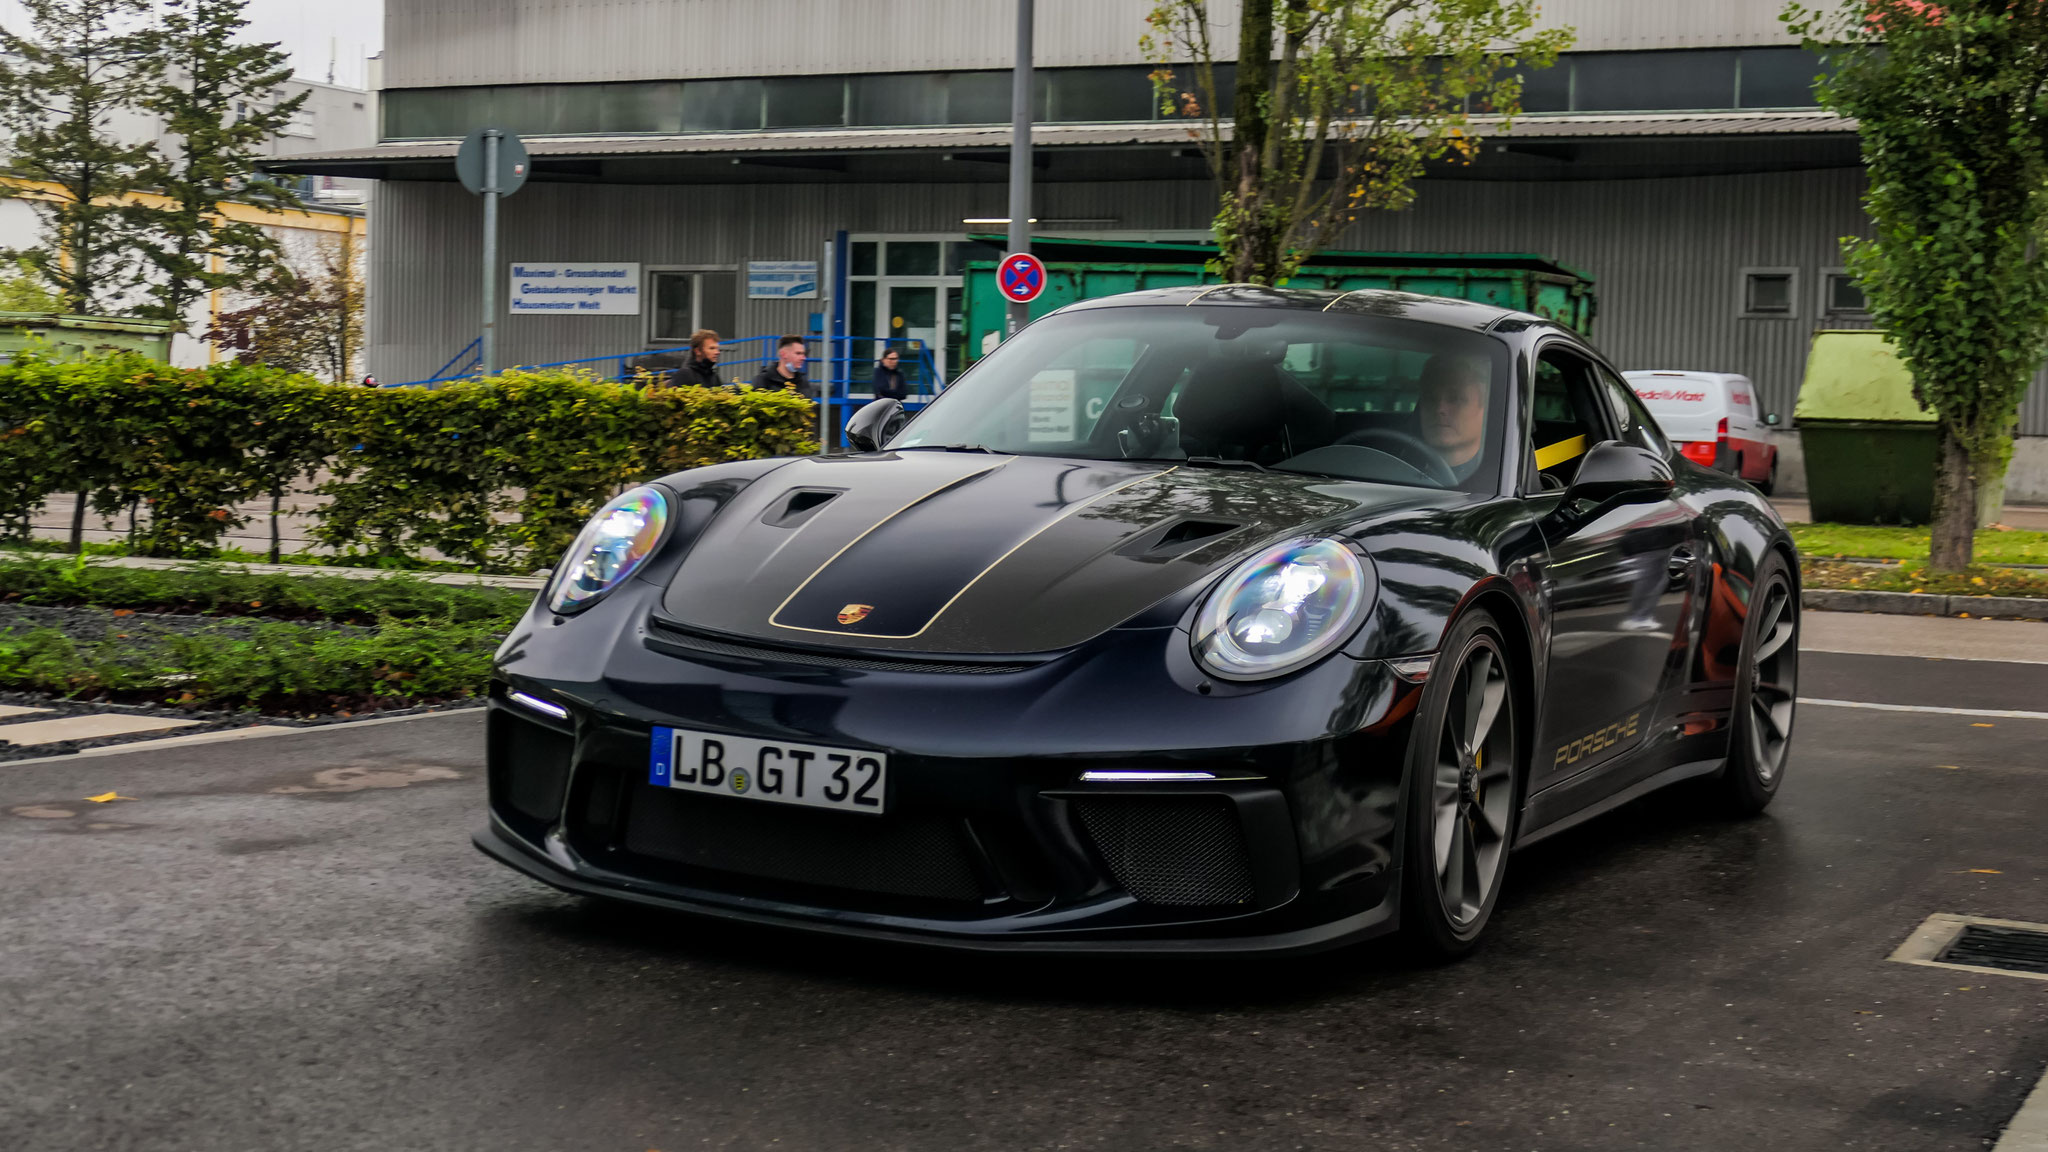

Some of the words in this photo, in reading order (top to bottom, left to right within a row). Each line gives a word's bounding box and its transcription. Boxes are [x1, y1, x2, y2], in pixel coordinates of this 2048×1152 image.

[655, 762, 666, 776] D
[673, 735, 726, 787] LB
[756, 745, 816, 798] GT
[822, 752, 882, 807] 32
[1552, 713, 1640, 771] PORSCHE
